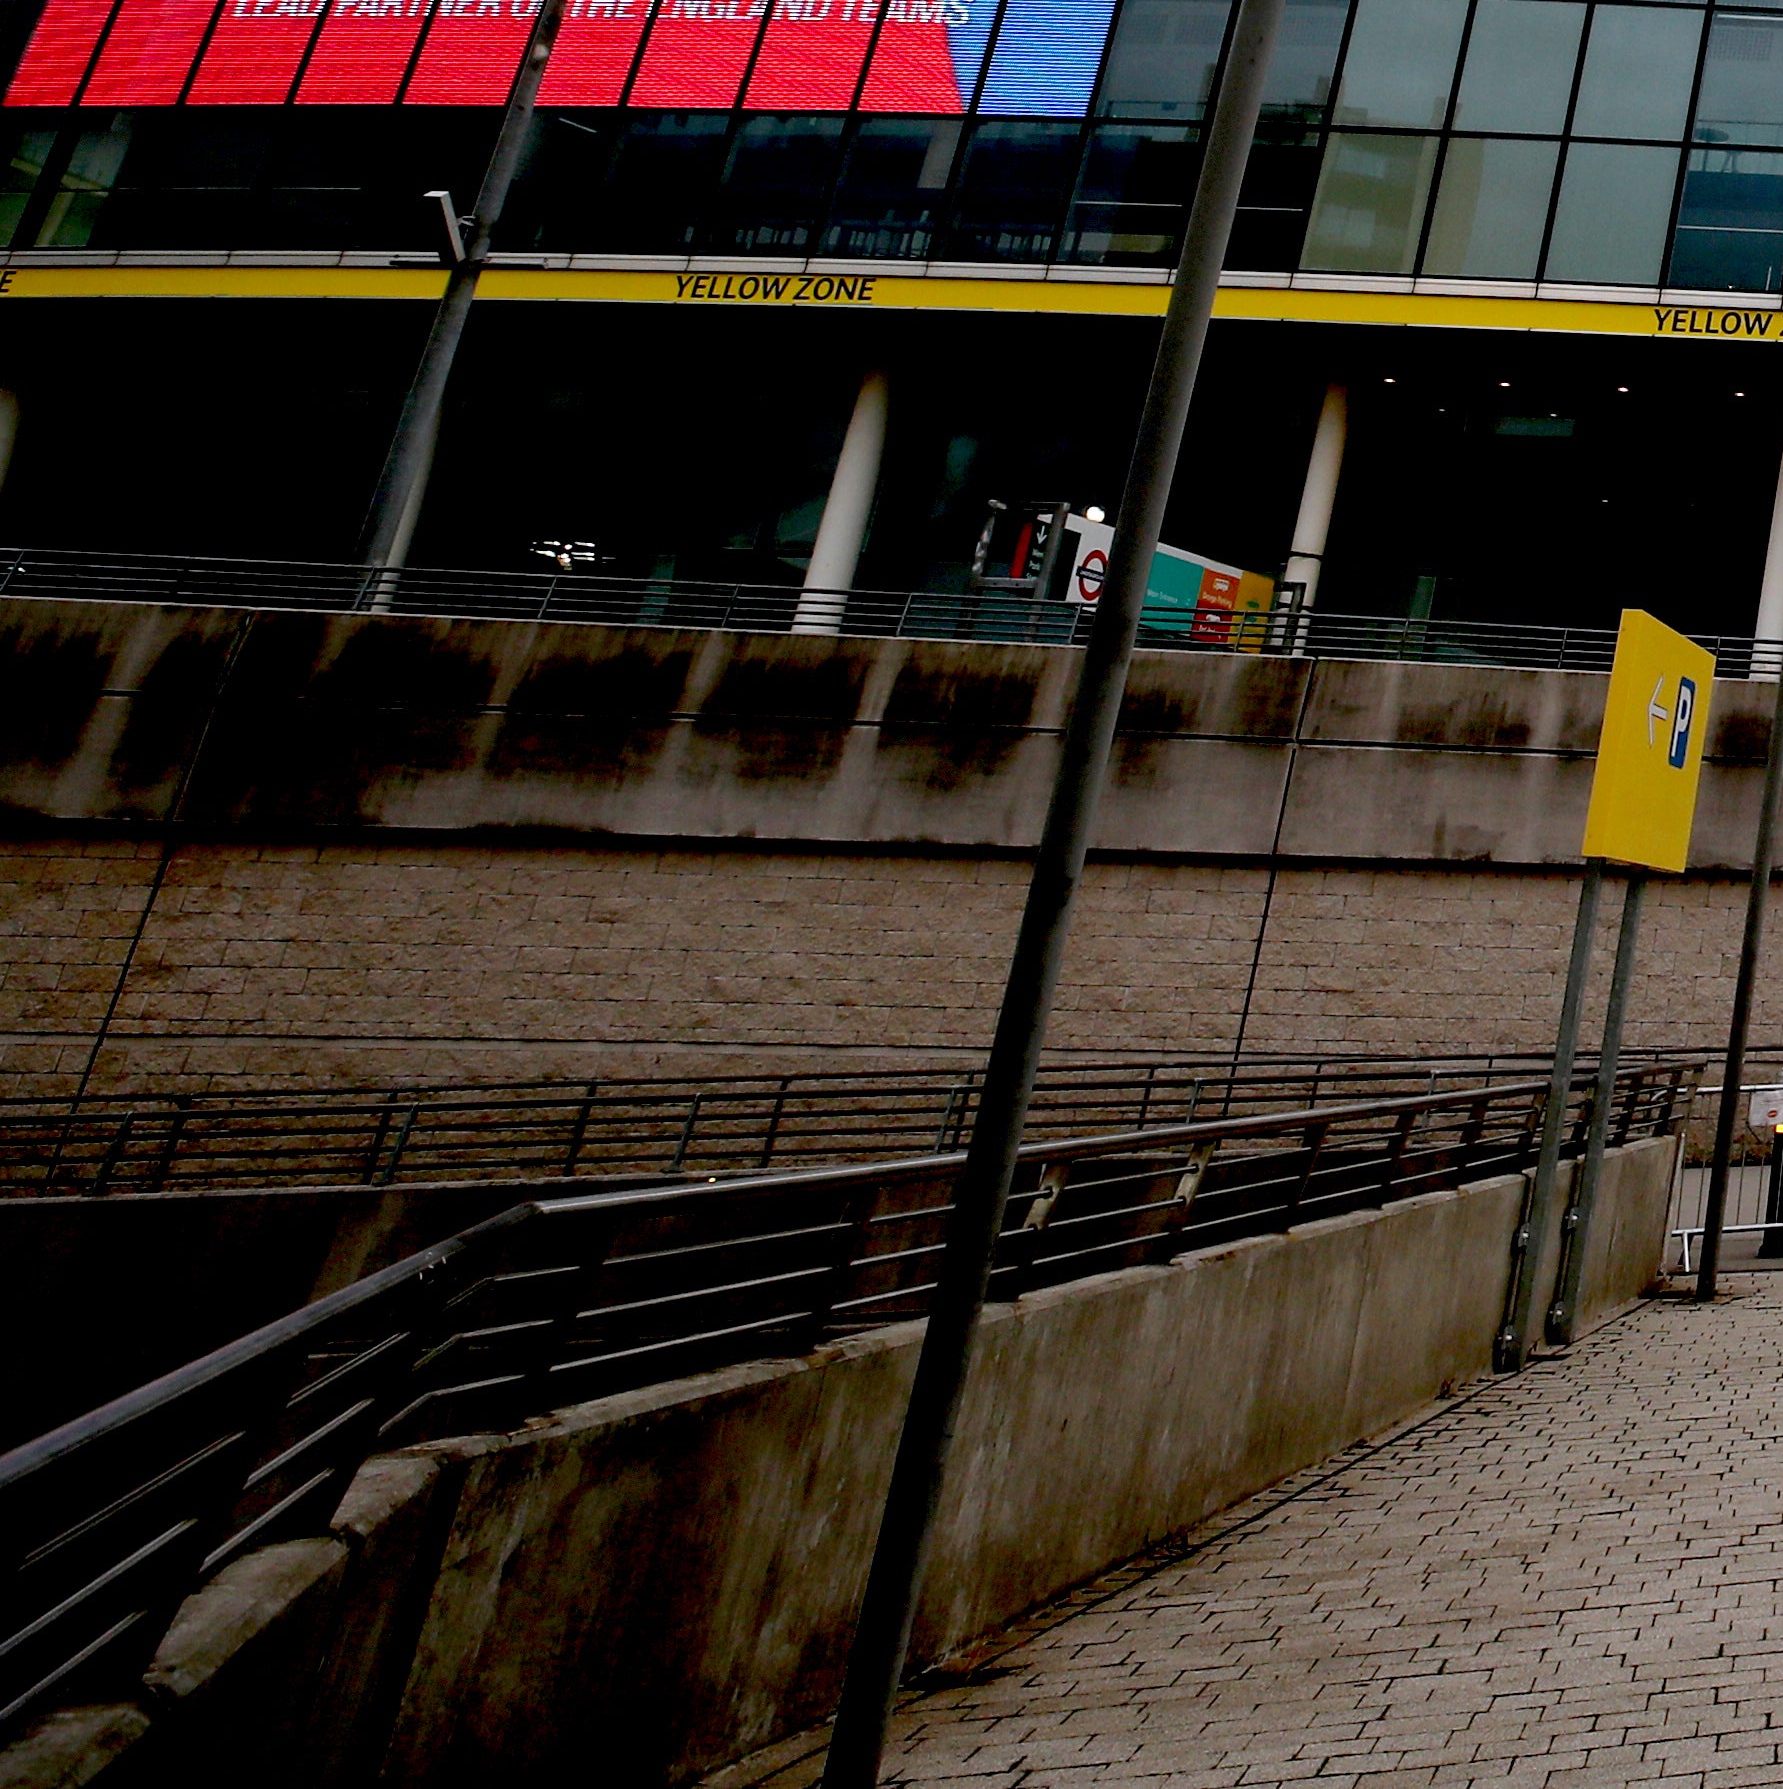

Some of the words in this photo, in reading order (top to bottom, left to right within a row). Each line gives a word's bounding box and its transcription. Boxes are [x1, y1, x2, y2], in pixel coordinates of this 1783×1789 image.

[676, 275, 791, 300] YELLOW
[793, 277, 876, 301] ZONE
[1654, 308, 1773, 336] YELLOW
[1671, 685, 1692, 757] P
